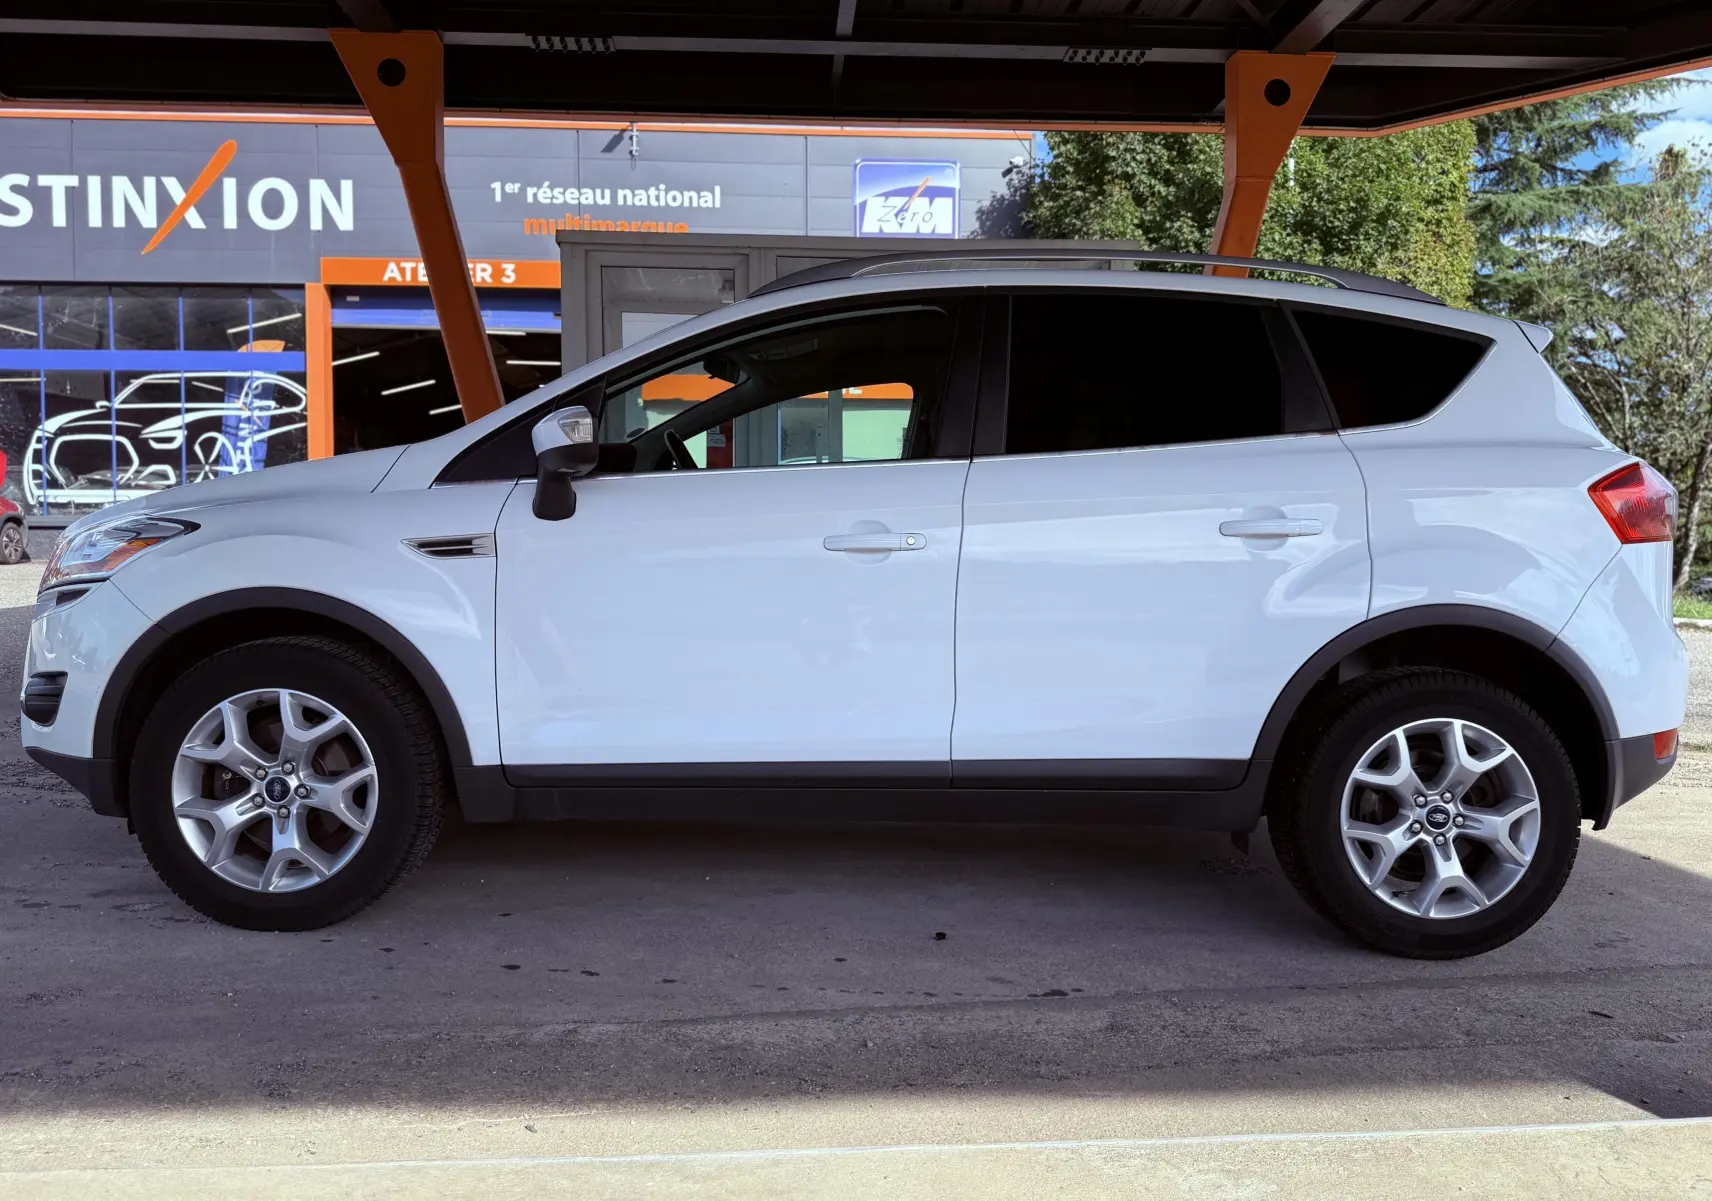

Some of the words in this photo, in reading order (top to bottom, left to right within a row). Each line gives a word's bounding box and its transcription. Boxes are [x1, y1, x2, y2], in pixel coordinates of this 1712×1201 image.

[526, 181, 611, 205] réseau
[617, 184, 721, 208] national
[861, 196, 953, 234] KM
[877, 205, 934, 223] Zero
[382, 261, 493, 284] ATER
[501, 263, 516, 283] 3
